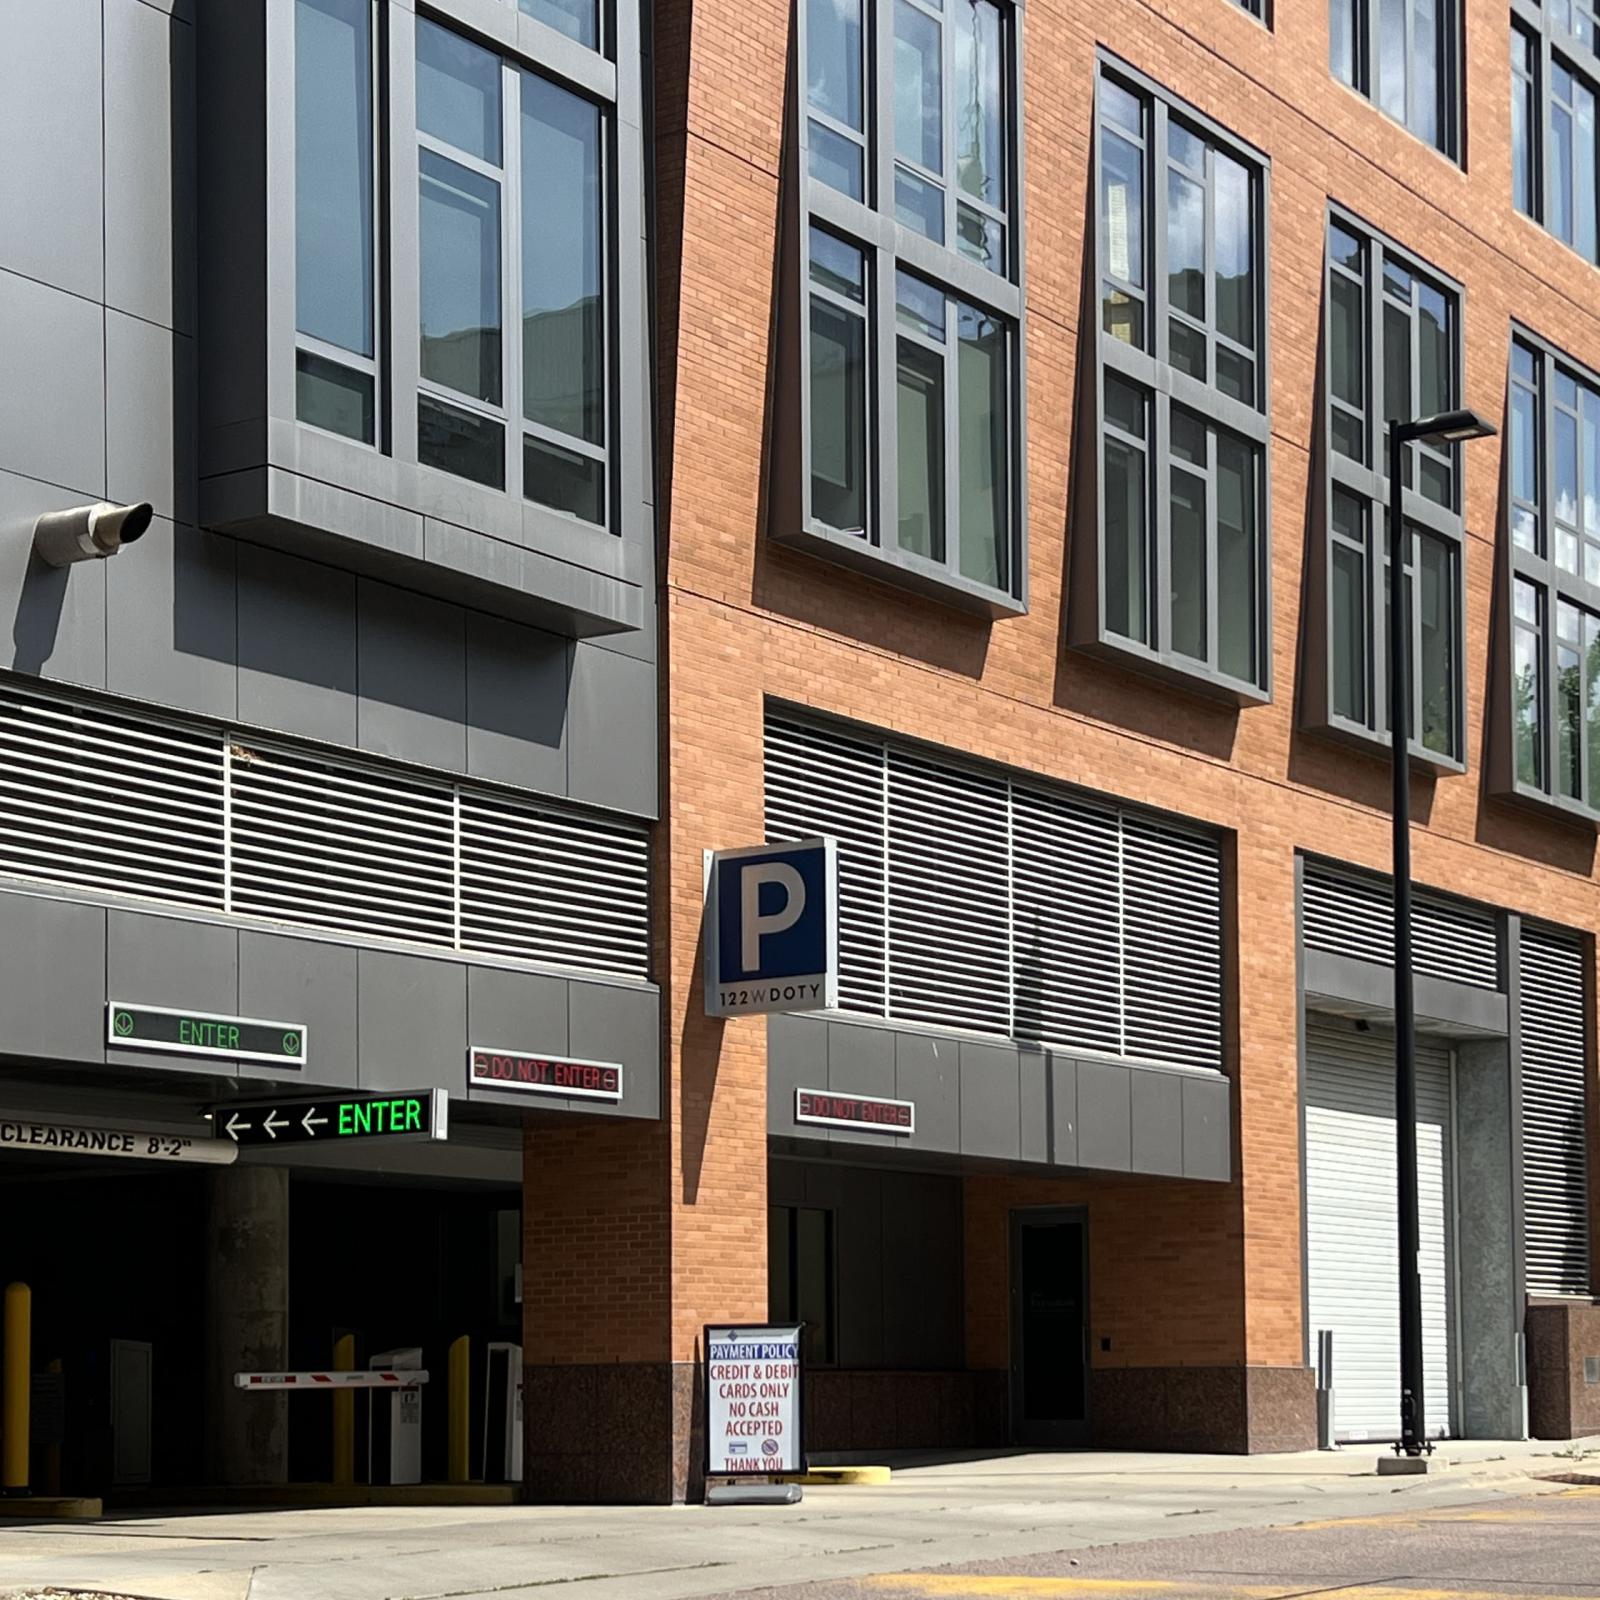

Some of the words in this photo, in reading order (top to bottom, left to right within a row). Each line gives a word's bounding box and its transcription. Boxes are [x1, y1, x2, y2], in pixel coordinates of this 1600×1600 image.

[741, 861, 806, 973] P
[179, 1019, 240, 1049] ENTER
[492, 1056, 514, 1079] DO
[517, 1059, 549, 1083] NOT
[554, 1063, 600, 1089] ENTER
[338, 1099, 421, 1134] ENTER
[813, 1095, 830, 1116] DO
[832, 1099, 858, 1119] NOT
[862, 1101, 897, 1124] ENTER
[0, 1123, 135, 1152] CLEARANCE
[710, 1344, 759, 1359] PAYMENT
[761, 1343, 799, 1359] POLICY
[710, 1364, 751, 1380] CREDIT
[753, 1364, 763, 1380] &
[765, 1364, 800, 1379] DEBIT
[719, 1382, 758, 1399] CARDS
[759, 1382, 789, 1398] ONLY
[729, 1402, 746, 1417] NO
[748, 1401, 779, 1417] CASH
[725, 1420, 783, 1436] ACCEPTED
[724, 1457, 760, 1472] THANK
[761, 1457, 783, 1471] YOU
